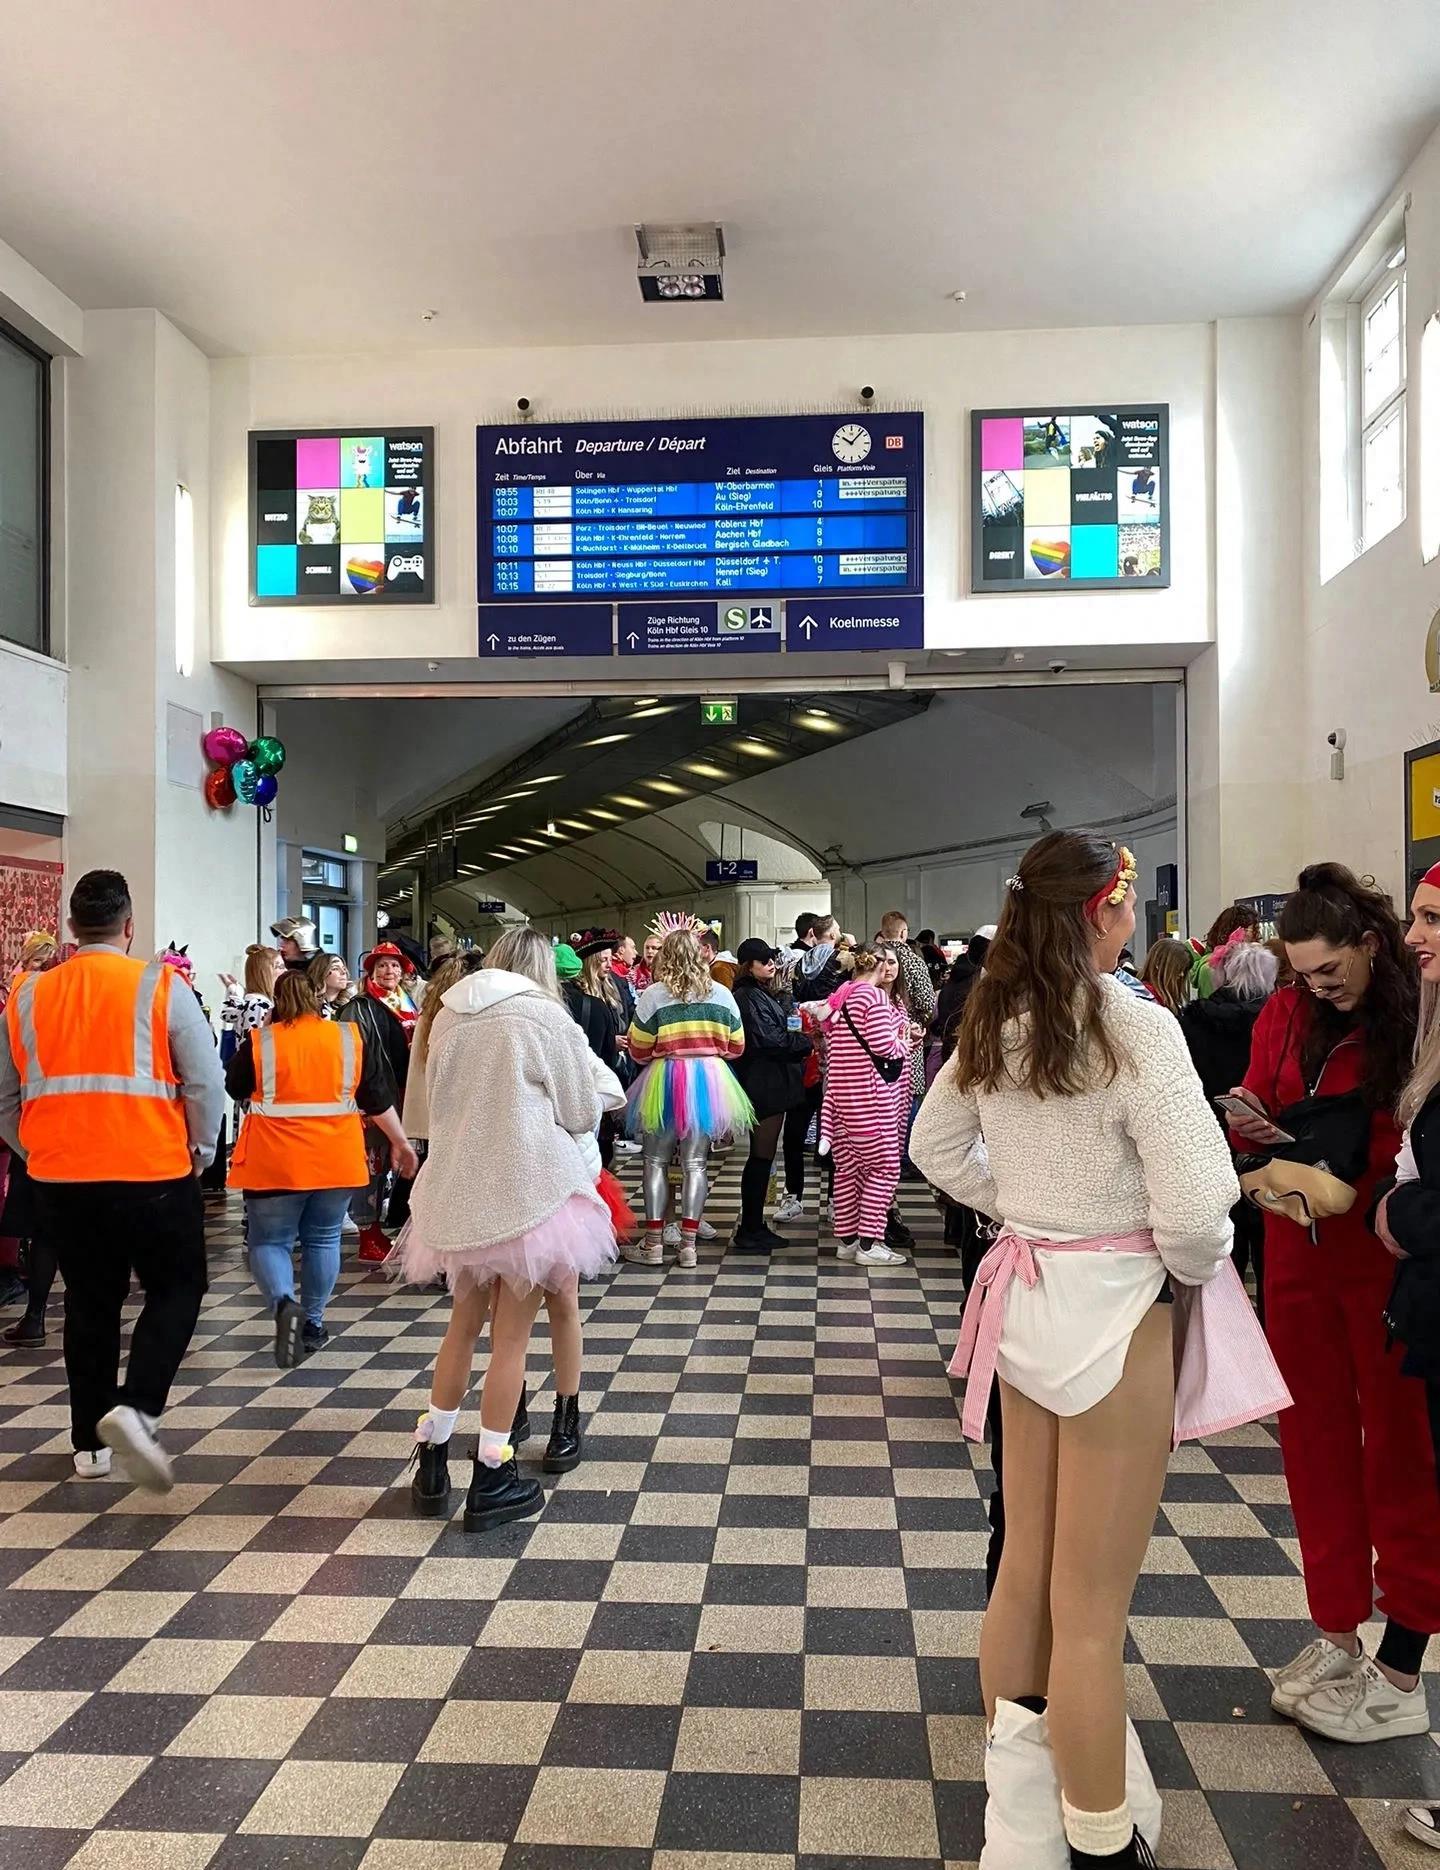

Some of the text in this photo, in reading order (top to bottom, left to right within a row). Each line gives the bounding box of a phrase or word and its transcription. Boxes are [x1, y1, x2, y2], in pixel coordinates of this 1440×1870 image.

[1122, 420, 1158, 429] watson
[389, 442, 423, 451] watson
[495, 437, 562, 454] Abfahrt
[576, 439, 644, 455] Departure
[658, 437, 706, 453] Départ
[887, 438, 902, 447] DB
[726, 467, 740, 475] Ziel
[814, 464, 832, 472] Gleis
[575, 470, 592, 480] Über
[715, 482, 774, 490] W-Oberbarmen
[496, 488, 518, 496] 09:55
[576, 487, 606, 496] Solingen
[626, 486, 664, 494] Wuppertal
[816, 490, 823, 498] 9
[715, 492, 752, 502] Au (Sieg)
[496, 498, 518, 506] 10:03
[715, 502, 774, 511] Köln-Ehrenfeld
[812, 500, 823, 508] 10
[496, 508, 518, 516] 10:07
[618, 506, 653, 515] Hansaring
[715, 519, 764, 528] Koblenz Hbf
[496, 525, 518, 533] 10:07
[817, 528, 823, 536] 8
[496, 535, 518, 543] 10:08
[817, 538, 823, 546] 9
[715, 539, 790, 550] Bergisch Gladbach
[716, 556, 781, 566] Düsseldorf T.
[813, 555, 823, 563] 10
[497, 562, 518, 570] 10:11
[817, 565, 823, 574] 9
[497, 572, 518, 580] 10:13
[615, 571, 667, 579] Siegburg/Bonn
[746, 567, 768, 577] (Sieg)
[716, 578, 731, 586] Kall
[817, 576, 823, 584] 7
[497, 582, 519, 591] 10:15
[647, 616, 700, 625] Züge Richtung
[727, 608, 744, 630] S
[830, 617, 900, 628] Koelnmesse
[647, 625, 708, 634] Köln Hbf Gleis 10
[533, 634, 556, 644] Zügen
[716, 862, 737, 874] 1-2
